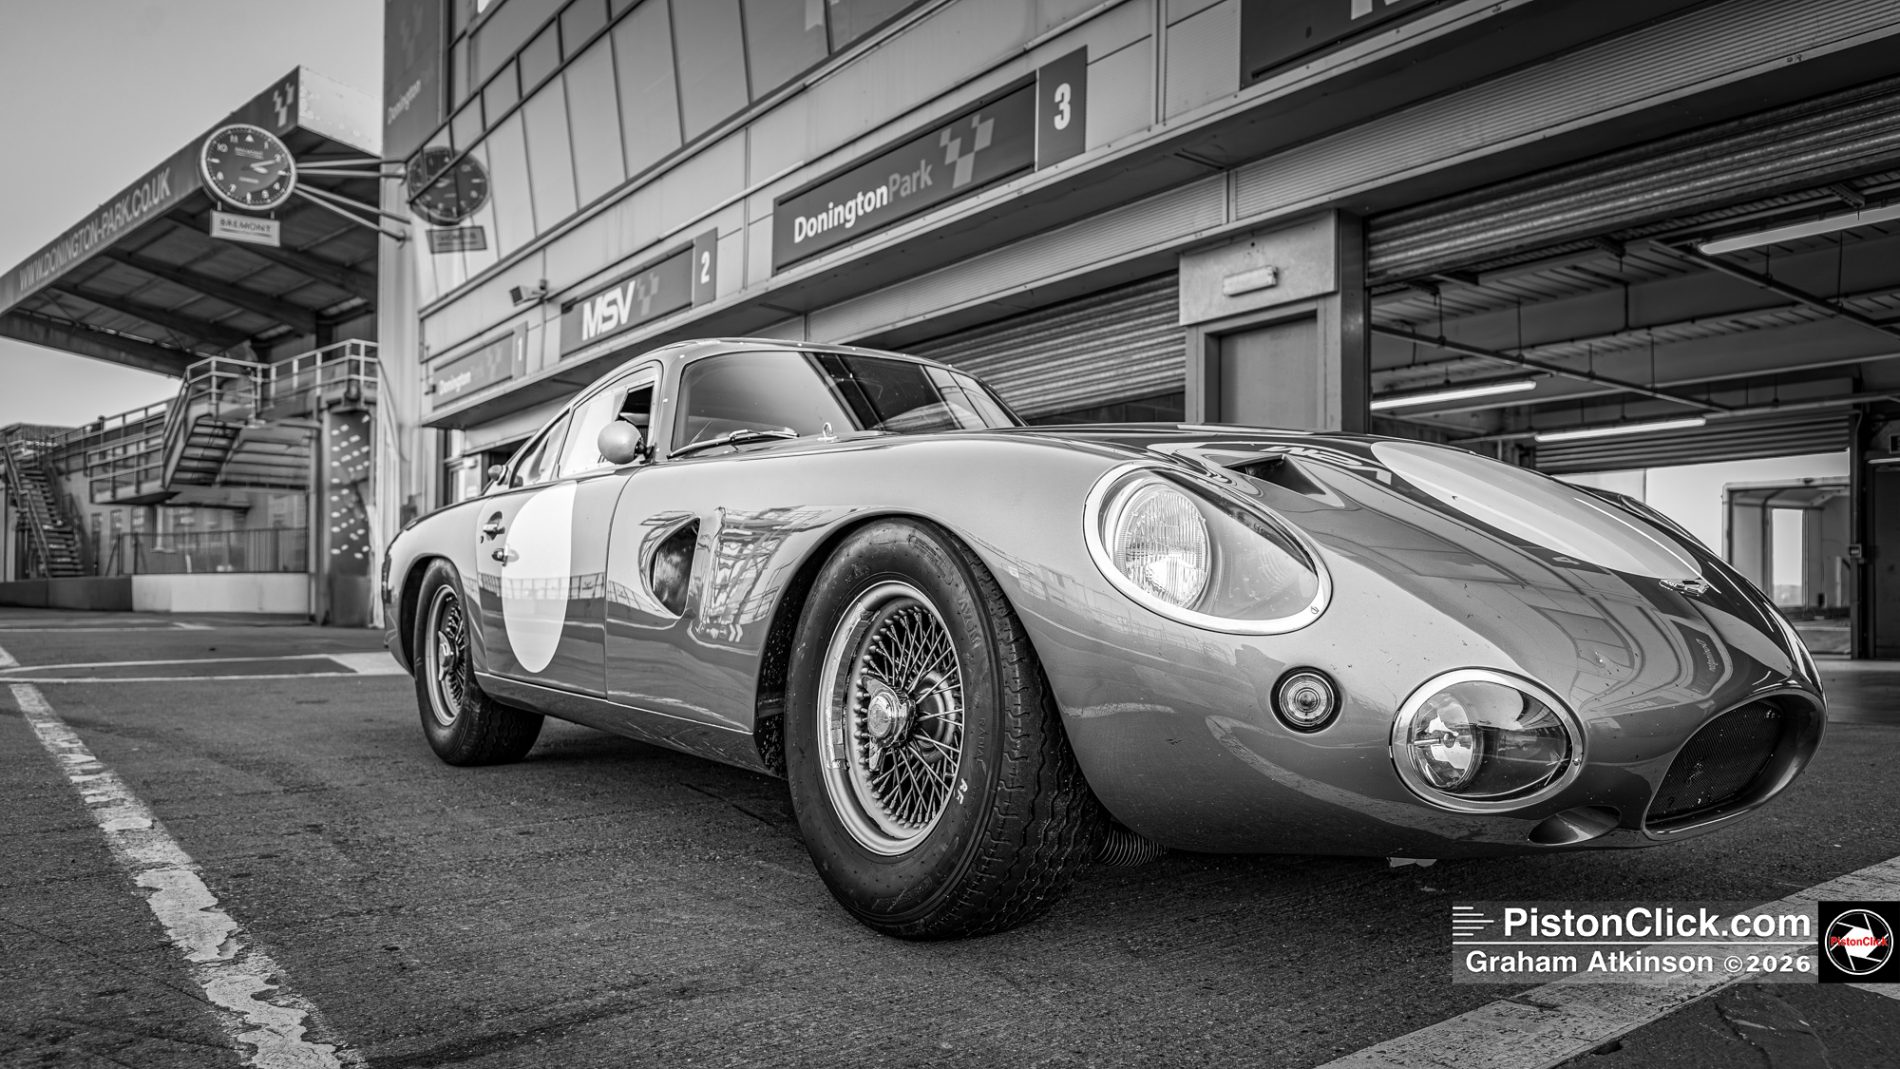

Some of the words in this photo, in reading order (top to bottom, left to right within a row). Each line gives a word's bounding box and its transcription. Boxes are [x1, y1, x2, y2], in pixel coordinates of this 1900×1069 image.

[1053, 82, 1072, 131] 3
[19, 166, 172, 292] WWW.DONINGTON-PARK.CO.UK
[220, 218, 272, 233] BREMONT
[700, 250, 710, 285] 2
[581, 279, 636, 342] MSV
[517, 336, 523, 362] 1
